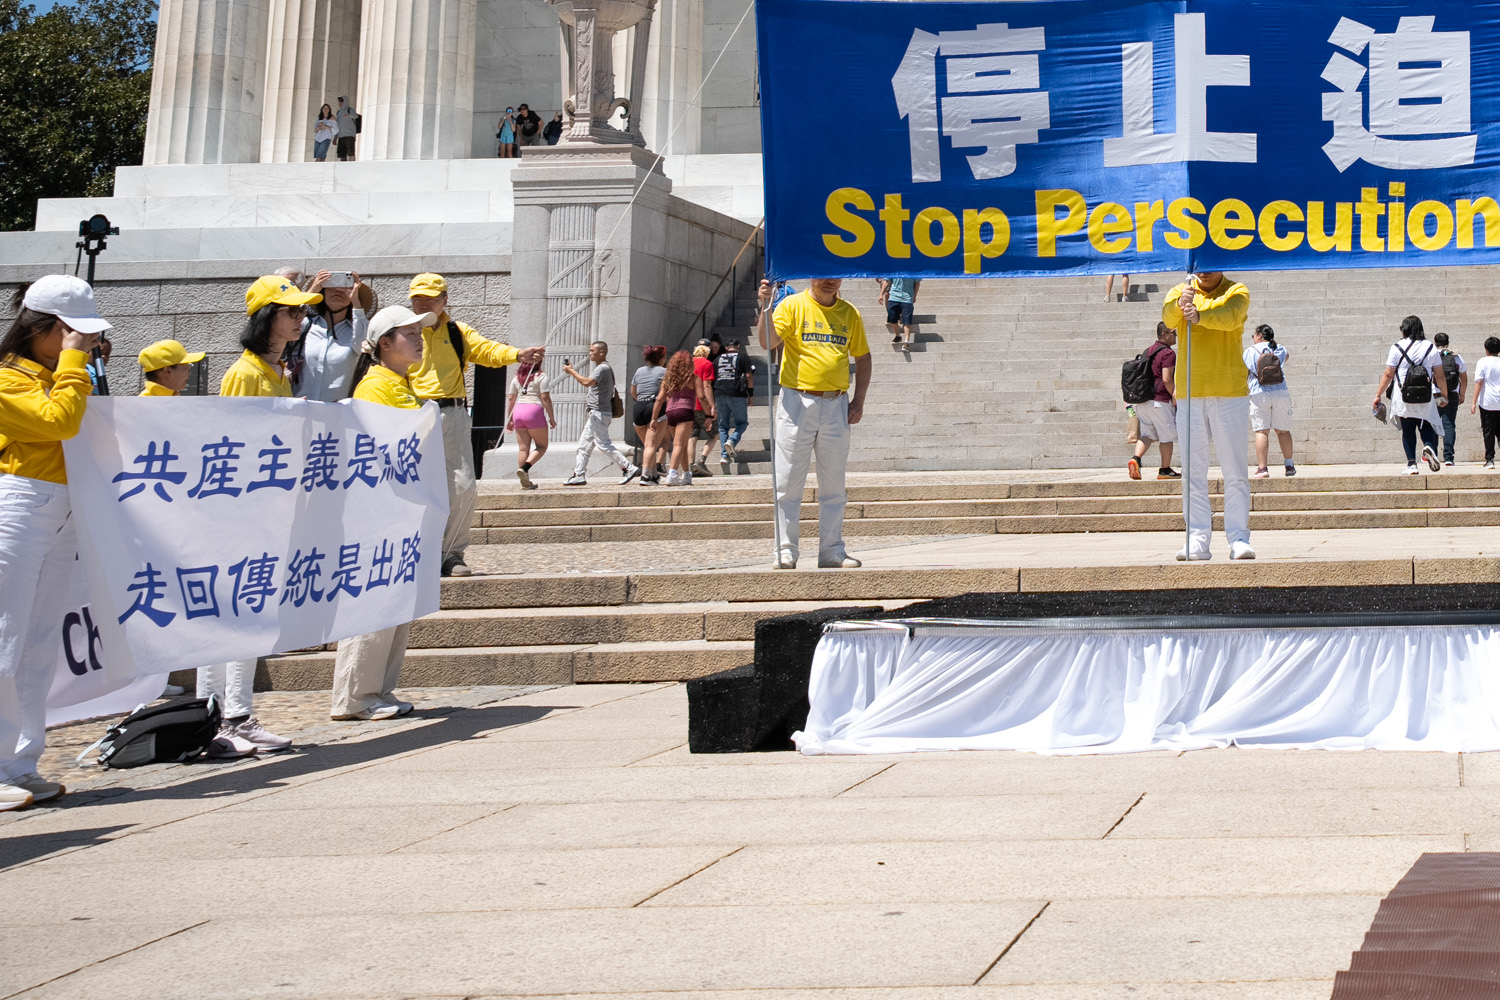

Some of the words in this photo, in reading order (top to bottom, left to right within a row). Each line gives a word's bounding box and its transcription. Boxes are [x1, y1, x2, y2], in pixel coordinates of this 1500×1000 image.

[822, 187, 1011, 274] Stop
[118, 531, 421, 628] 走回傳統是出路
